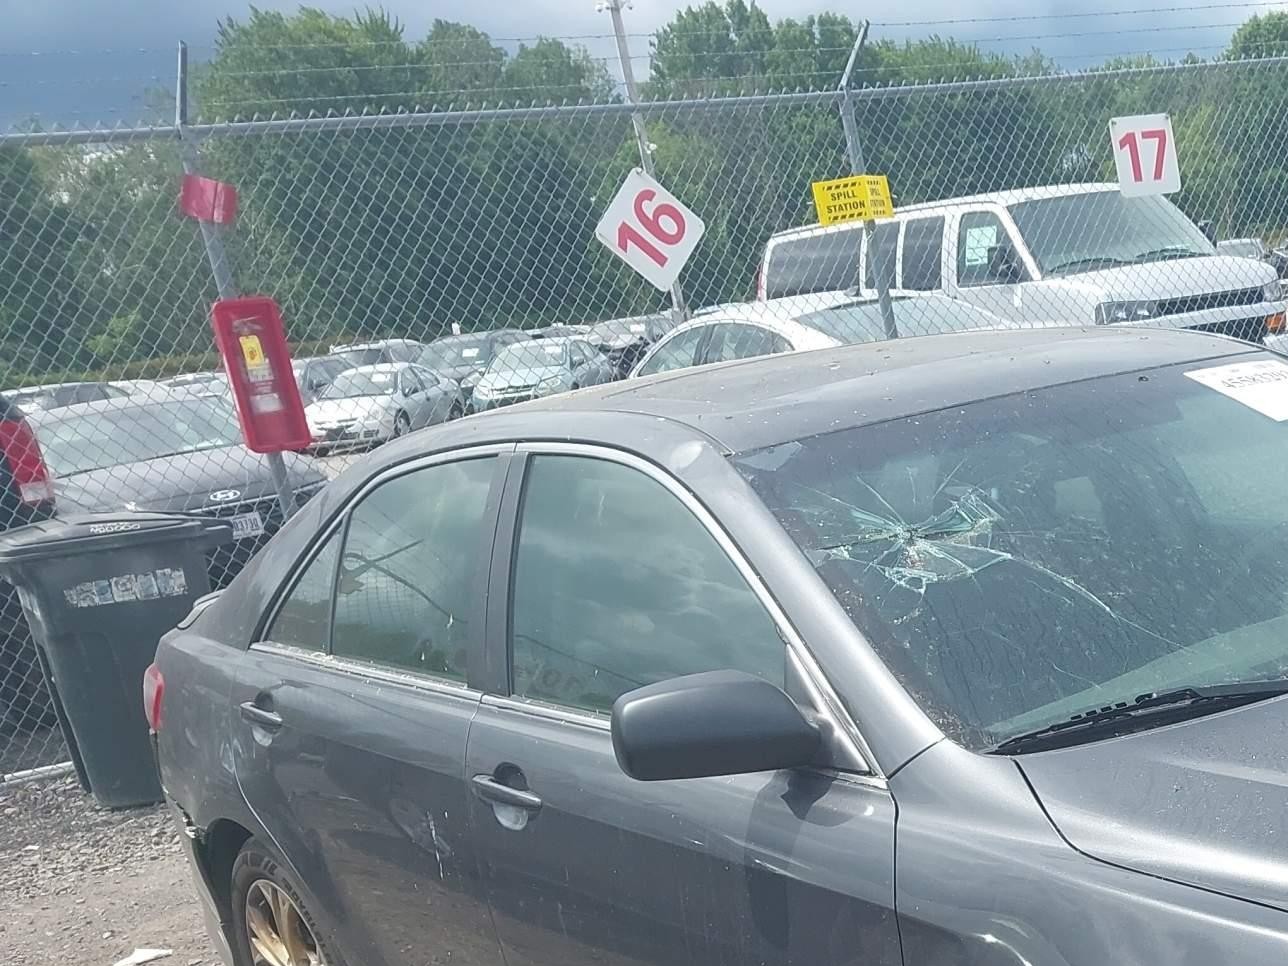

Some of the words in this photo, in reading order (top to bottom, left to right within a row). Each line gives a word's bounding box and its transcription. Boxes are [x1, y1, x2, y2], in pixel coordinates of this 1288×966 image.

[1118, 129, 1168, 183] 17
[826, 200, 866, 214] STATION
[831, 190, 857, 201] SPILL
[617, 188, 686, 268] 16
